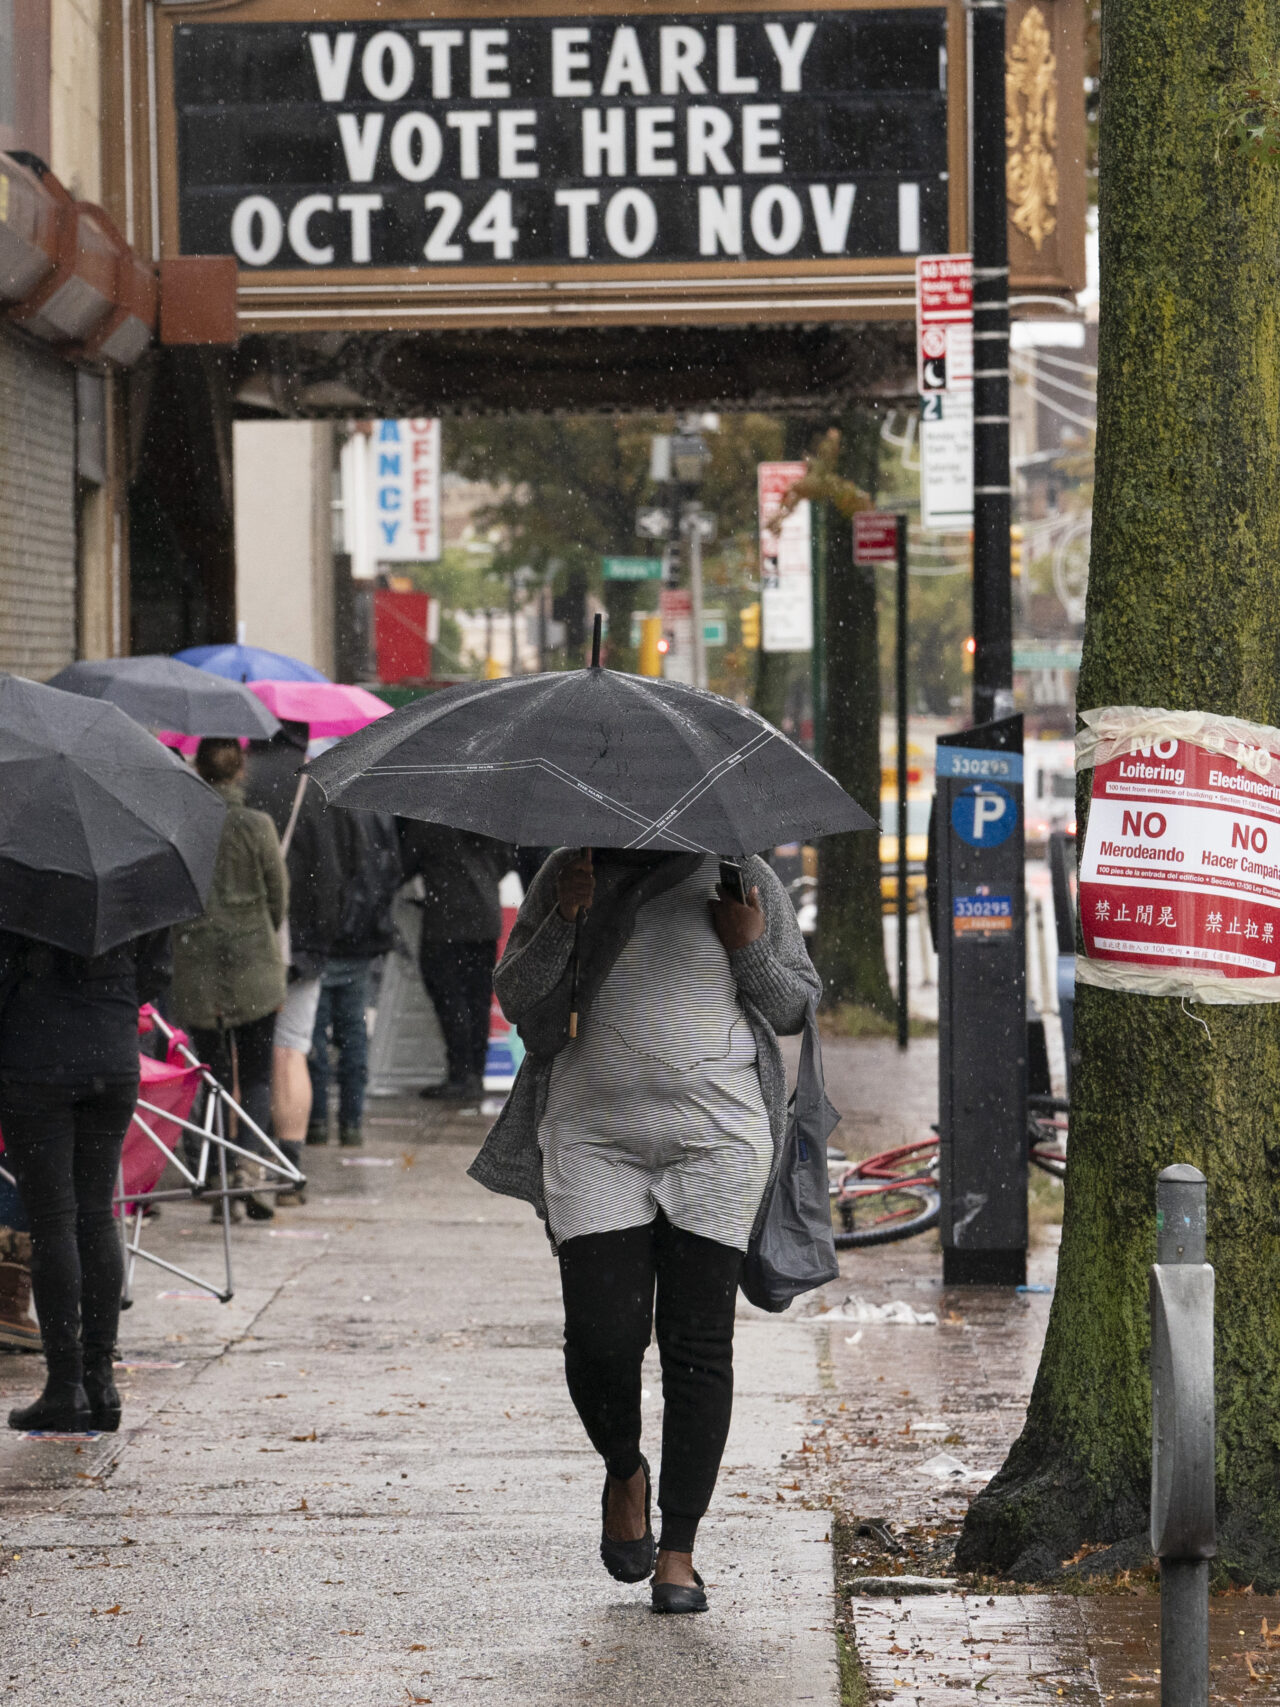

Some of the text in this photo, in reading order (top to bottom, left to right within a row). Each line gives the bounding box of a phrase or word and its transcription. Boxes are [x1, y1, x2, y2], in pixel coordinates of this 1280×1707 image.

[309, 22, 817, 102] VOTE EARLY
[337, 104, 784, 182] VOTE HERE
[231, 192, 383, 266] OCT
[423, 189, 519, 261] 24
[555, 187, 658, 258] TO
[698, 183, 857, 255] NOV
[923, 262, 939, 279] NO
[923, 394, 939, 420] 2
[1130, 734, 1179, 760] NO
[1236, 742, 1272, 776] NO
[1119, 761, 1186, 785] Loitering
[1148, 787, 1177, 796] entrance
[1178, 789, 1185, 797] of
[1186, 790, 1213, 801] building
[973, 793, 1006, 839] P
[1121, 810, 1167, 839] NO
[1231, 822, 1268, 854] NO
[1100, 841, 1185, 863] Merodeando
[1201, 850, 1238, 870] Hacer
[1110, 867, 1124, 875] pies
[1125, 868, 1133, 876] de
[1141, 870, 1166, 879] entrada
[1167, 872, 1178, 880] del
[1179, 873, 1204, 883] edificio
[1210, 876, 1236, 888] Sección
[955, 901, 1010, 916] 330295
[1095, 899, 1177, 928] 禁止閒晃
[1205, 911, 1274, 944] 禁止拉票
